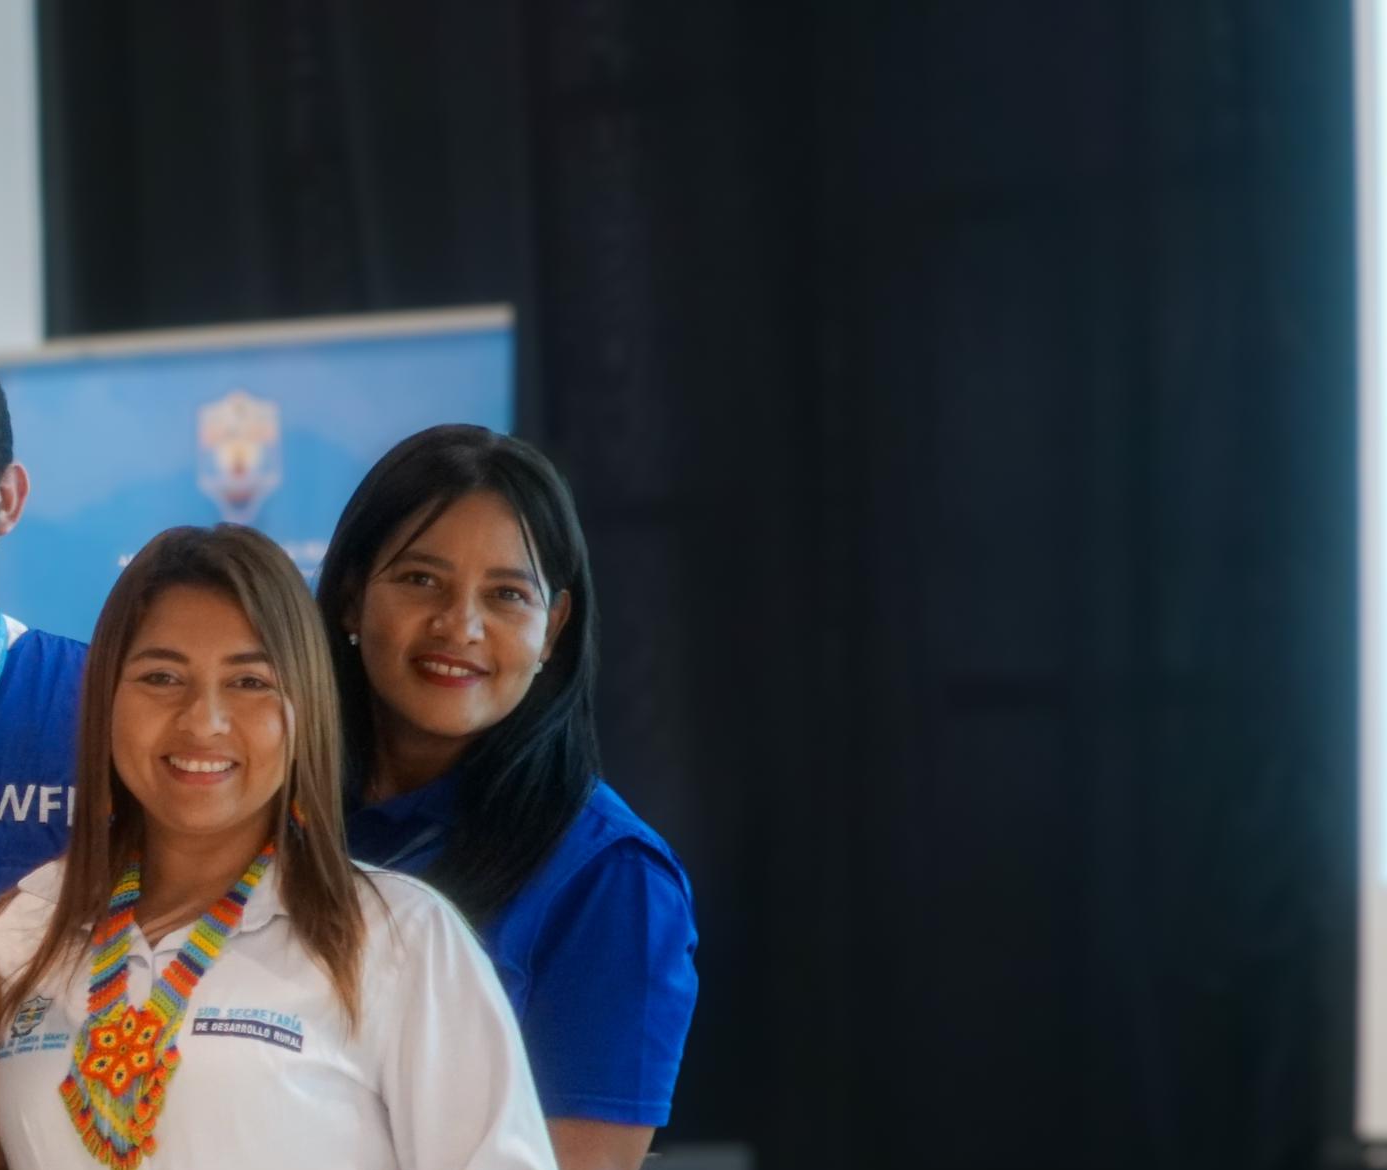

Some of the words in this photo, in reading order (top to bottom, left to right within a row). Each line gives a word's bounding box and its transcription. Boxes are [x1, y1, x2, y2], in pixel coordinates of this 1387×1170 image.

[194, 1021, 208, 1032] DE
[211, 1022, 270, 1038] DESARROLLO
[272, 1030, 301, 1049] RURAL
